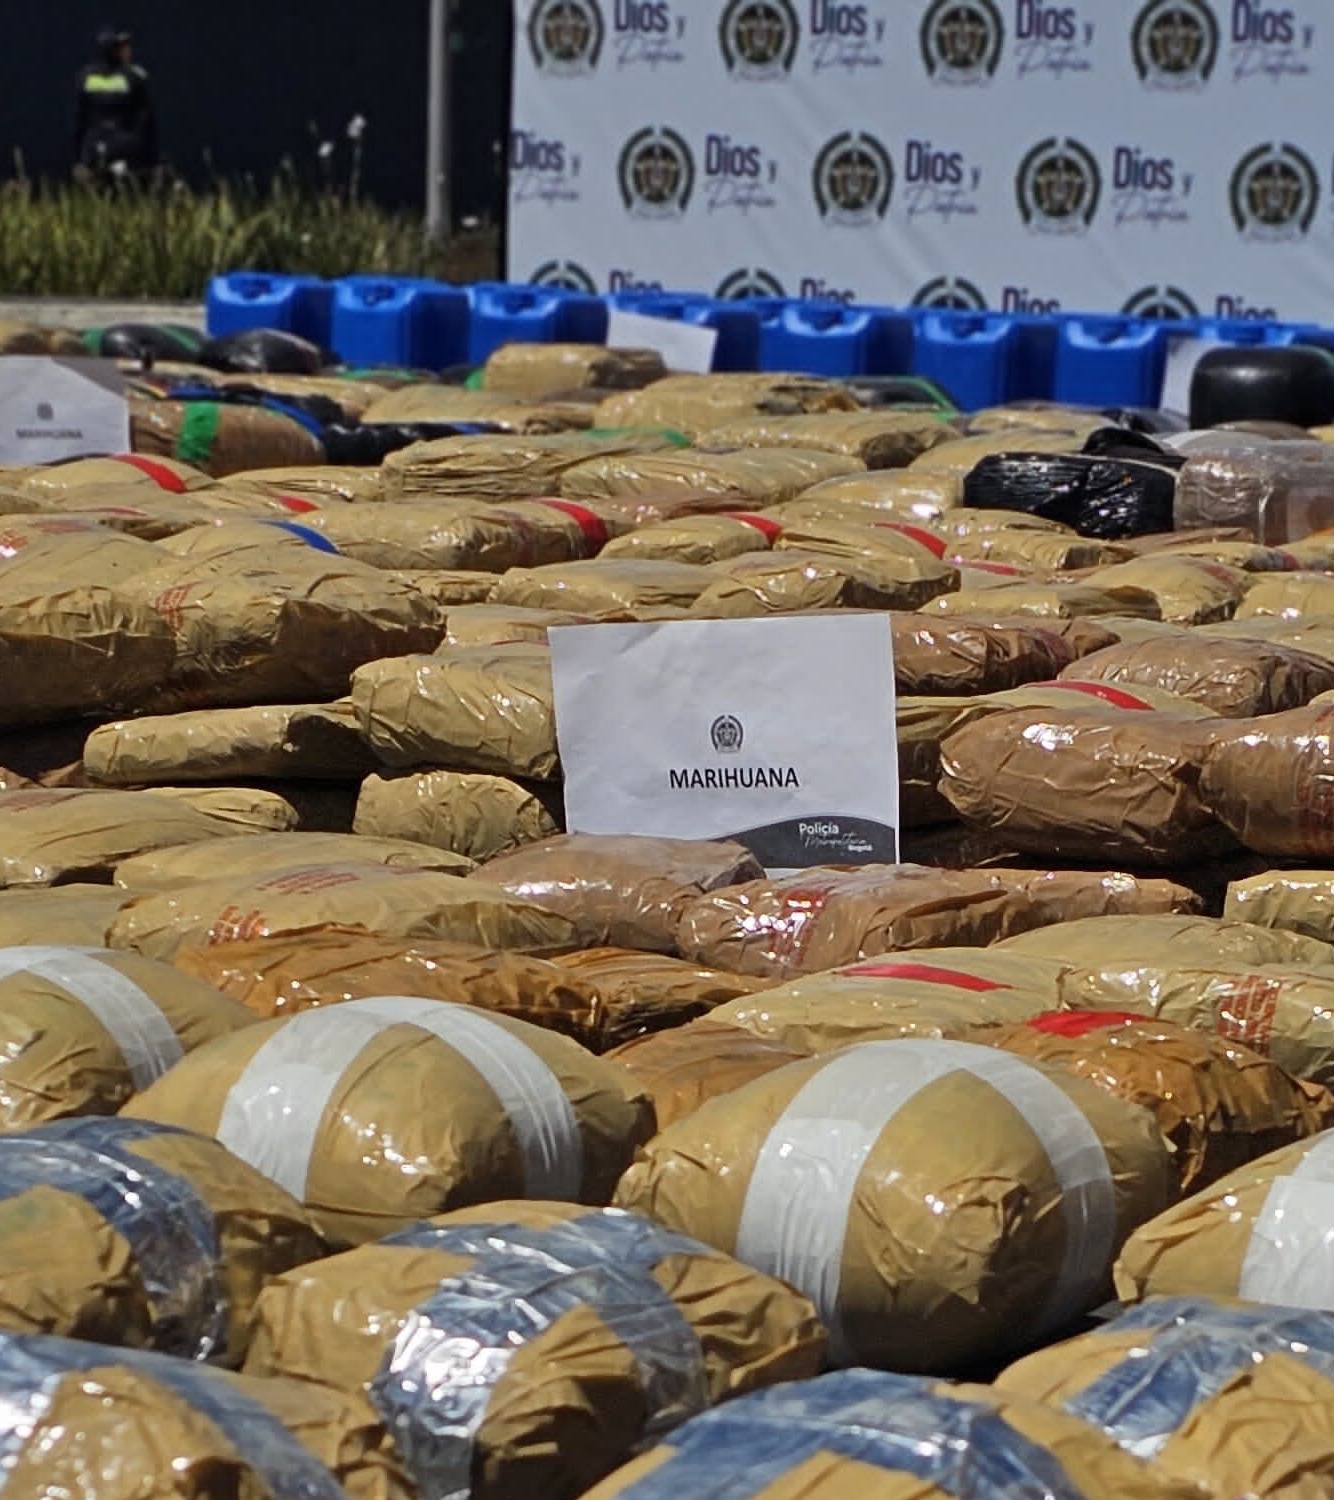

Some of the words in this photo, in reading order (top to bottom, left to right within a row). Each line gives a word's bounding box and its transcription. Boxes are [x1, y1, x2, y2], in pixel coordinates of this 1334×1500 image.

[614, 0, 669, 33] Dios
[811, 0, 867, 35] Dios
[1016, 0, 1075, 39] Dios
[1232, 0, 1294, 43] Dios
[511, 129, 565, 172] Dios
[705, 134, 761, 177] Dios
[905, 140, 963, 184] Dios
[1113, 146, 1174, 190] Dios
[669, 767, 799, 789] MARIHUANA
